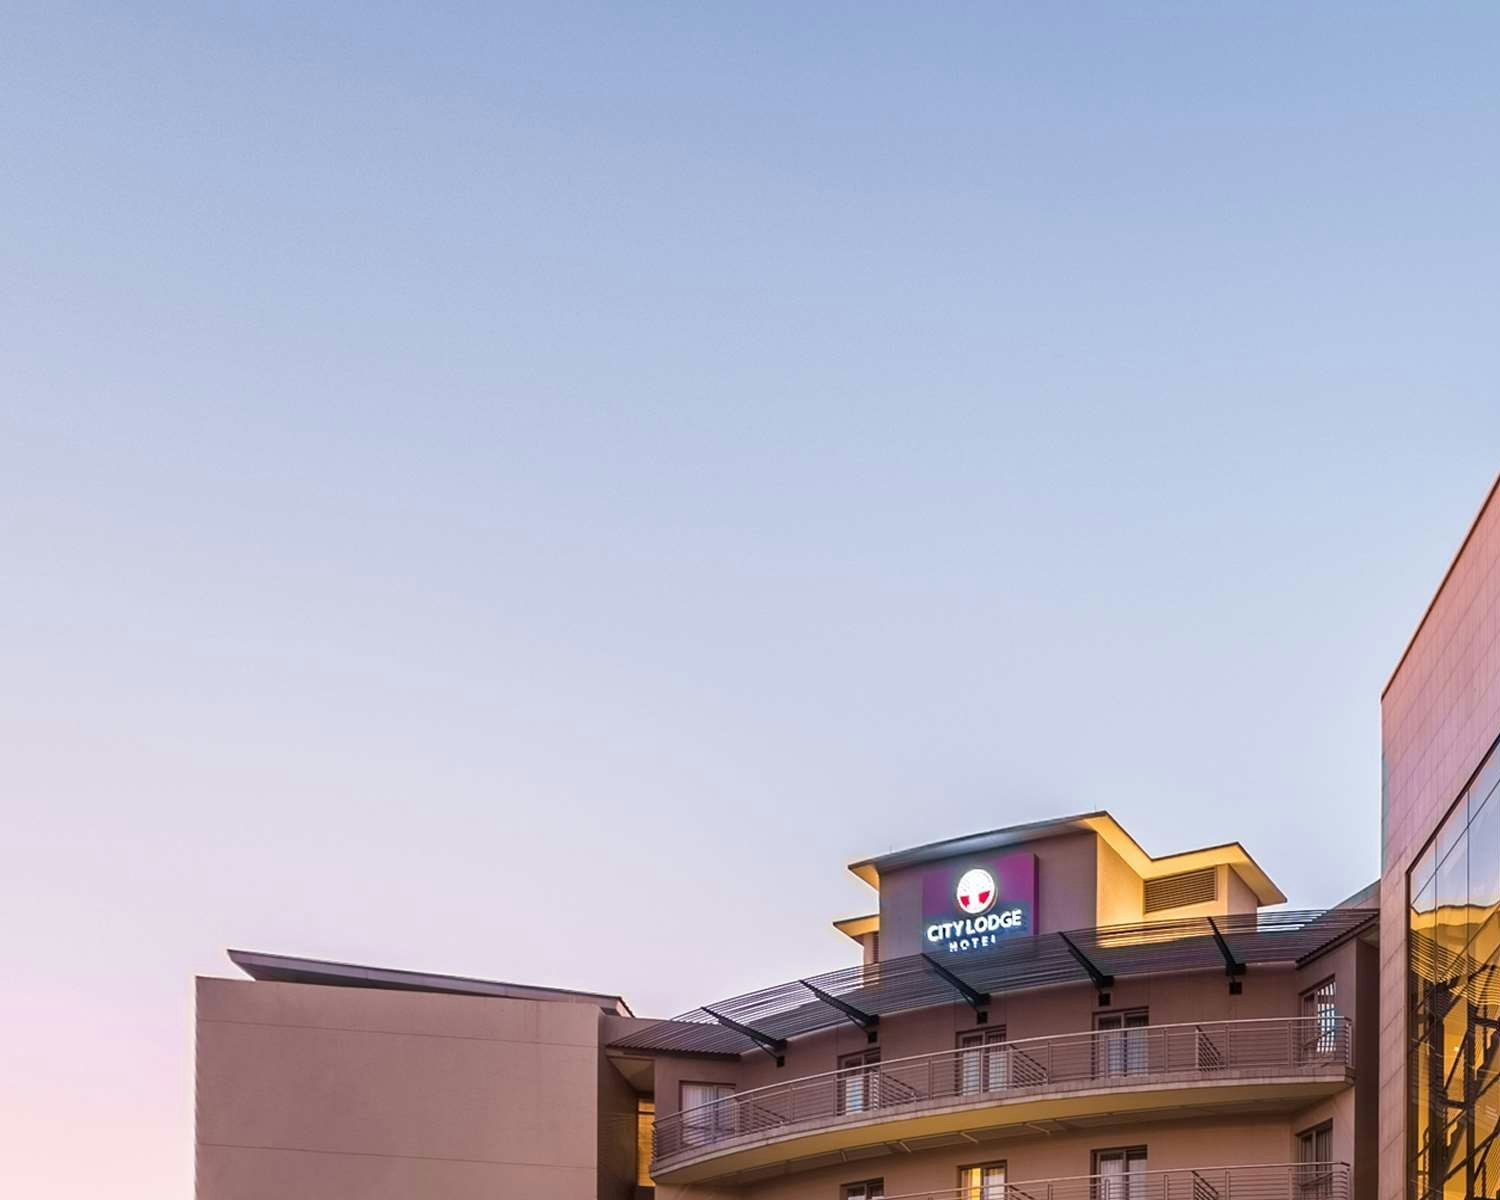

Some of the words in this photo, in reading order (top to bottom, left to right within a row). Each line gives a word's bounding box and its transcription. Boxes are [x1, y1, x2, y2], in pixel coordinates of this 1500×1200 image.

[926, 919, 964, 942] CITY
[965, 908, 1022, 936] LODGE
[949, 935, 996, 952] HOTEL
